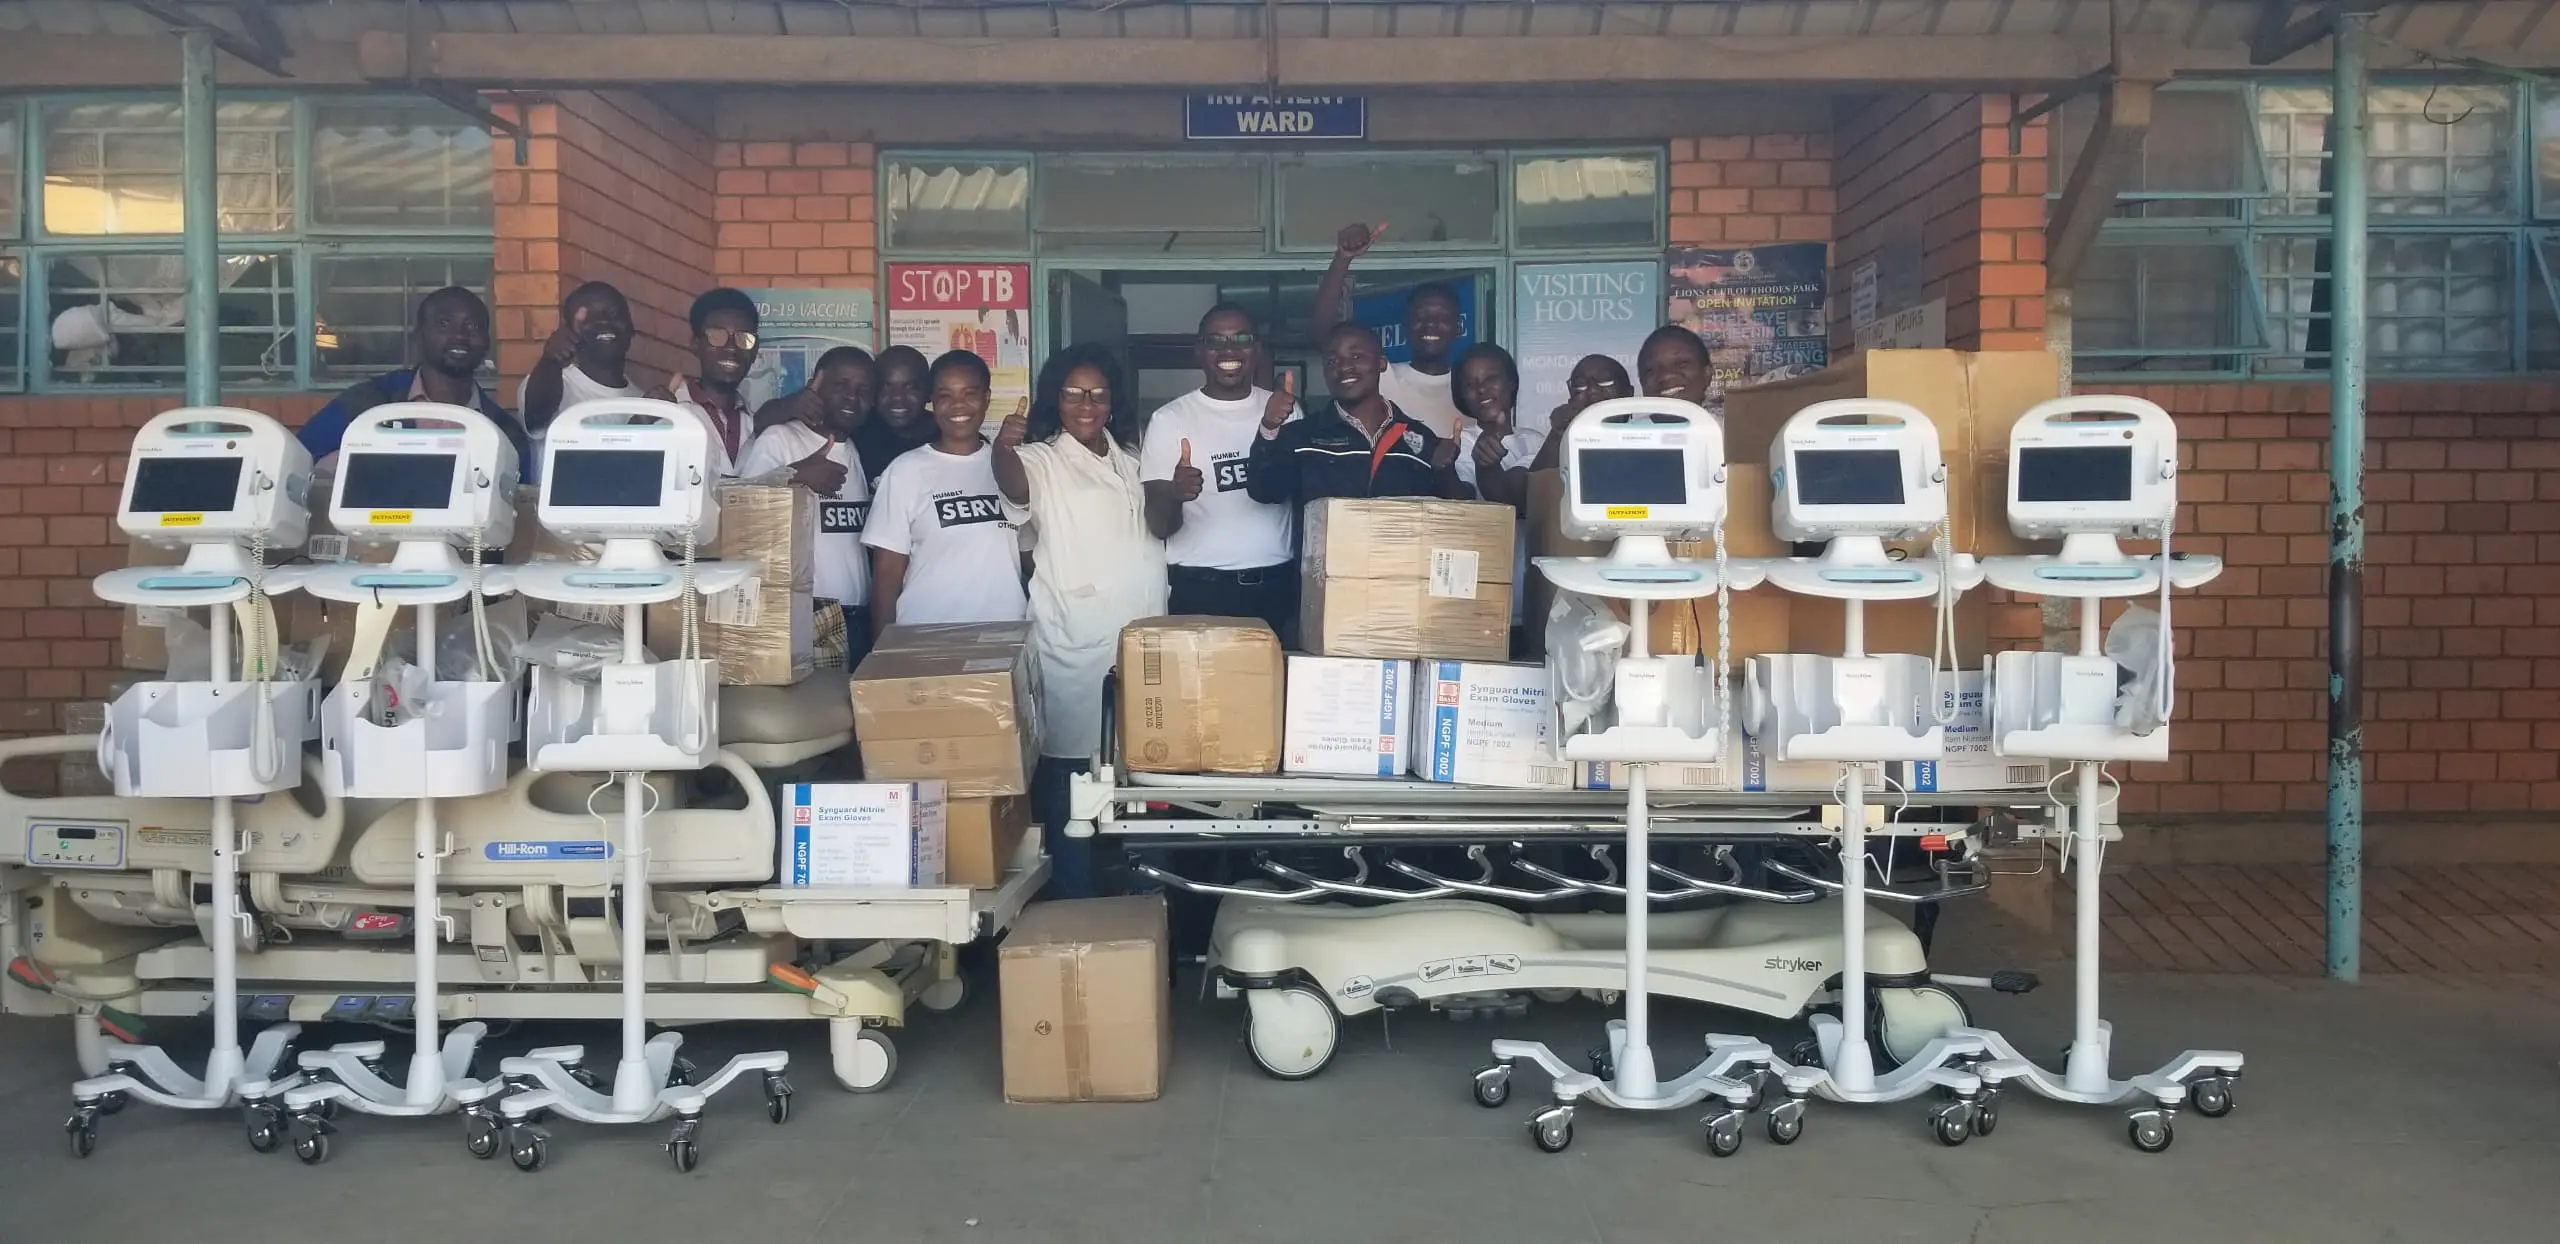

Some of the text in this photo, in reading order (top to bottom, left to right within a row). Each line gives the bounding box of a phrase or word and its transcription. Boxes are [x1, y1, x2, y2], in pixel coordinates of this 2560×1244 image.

[1236, 111, 1314, 132] WARD
[901, 269, 1014, 302] STOP TB
[1521, 272, 1645, 296] VISITING
[1751, 285, 1790, 296] RHODES
[1793, 283, 1819, 293] PARK
[800, 301, 860, 317] VACCINE
[1535, 297, 1634, 322] HOURS
[1697, 295, 1797, 309] OPEN INVITATION
[1752, 311, 1787, 325] EYE
[1702, 325, 1787, 340] SCREENING
[1751, 349, 1824, 365] TESTING
[1210, 451, 1240, 461] HUMBLY
[1220, 463, 1249, 485] SE
[932, 490, 963, 500] HUMBLY
[824, 507, 867, 527] SERV
[942, 499, 1001, 520] SERV
[1383, 668, 1395, 720] NGPF 7002
[1470, 683, 1547, 697] Synguard Nitri
[1470, 693, 1536, 705] Exam Gloves
[1468, 718, 1503, 728] Medium
[1944, 725, 1979, 733] Medium
[1438, 718, 1452, 775] NGPF 7002
[1945, 744, 1989, 753] NGPF 7002
[1750, 736, 1760, 785] GPF 7002
[1594, 761, 1605, 782] 002
[889, 791, 899, 800] M
[818, 806, 858, 815] Synguard
[498, 843, 548, 855] Hill-Rom
[797, 841, 807, 870] NGPF
[1764, 955, 1823, 973] stryker
